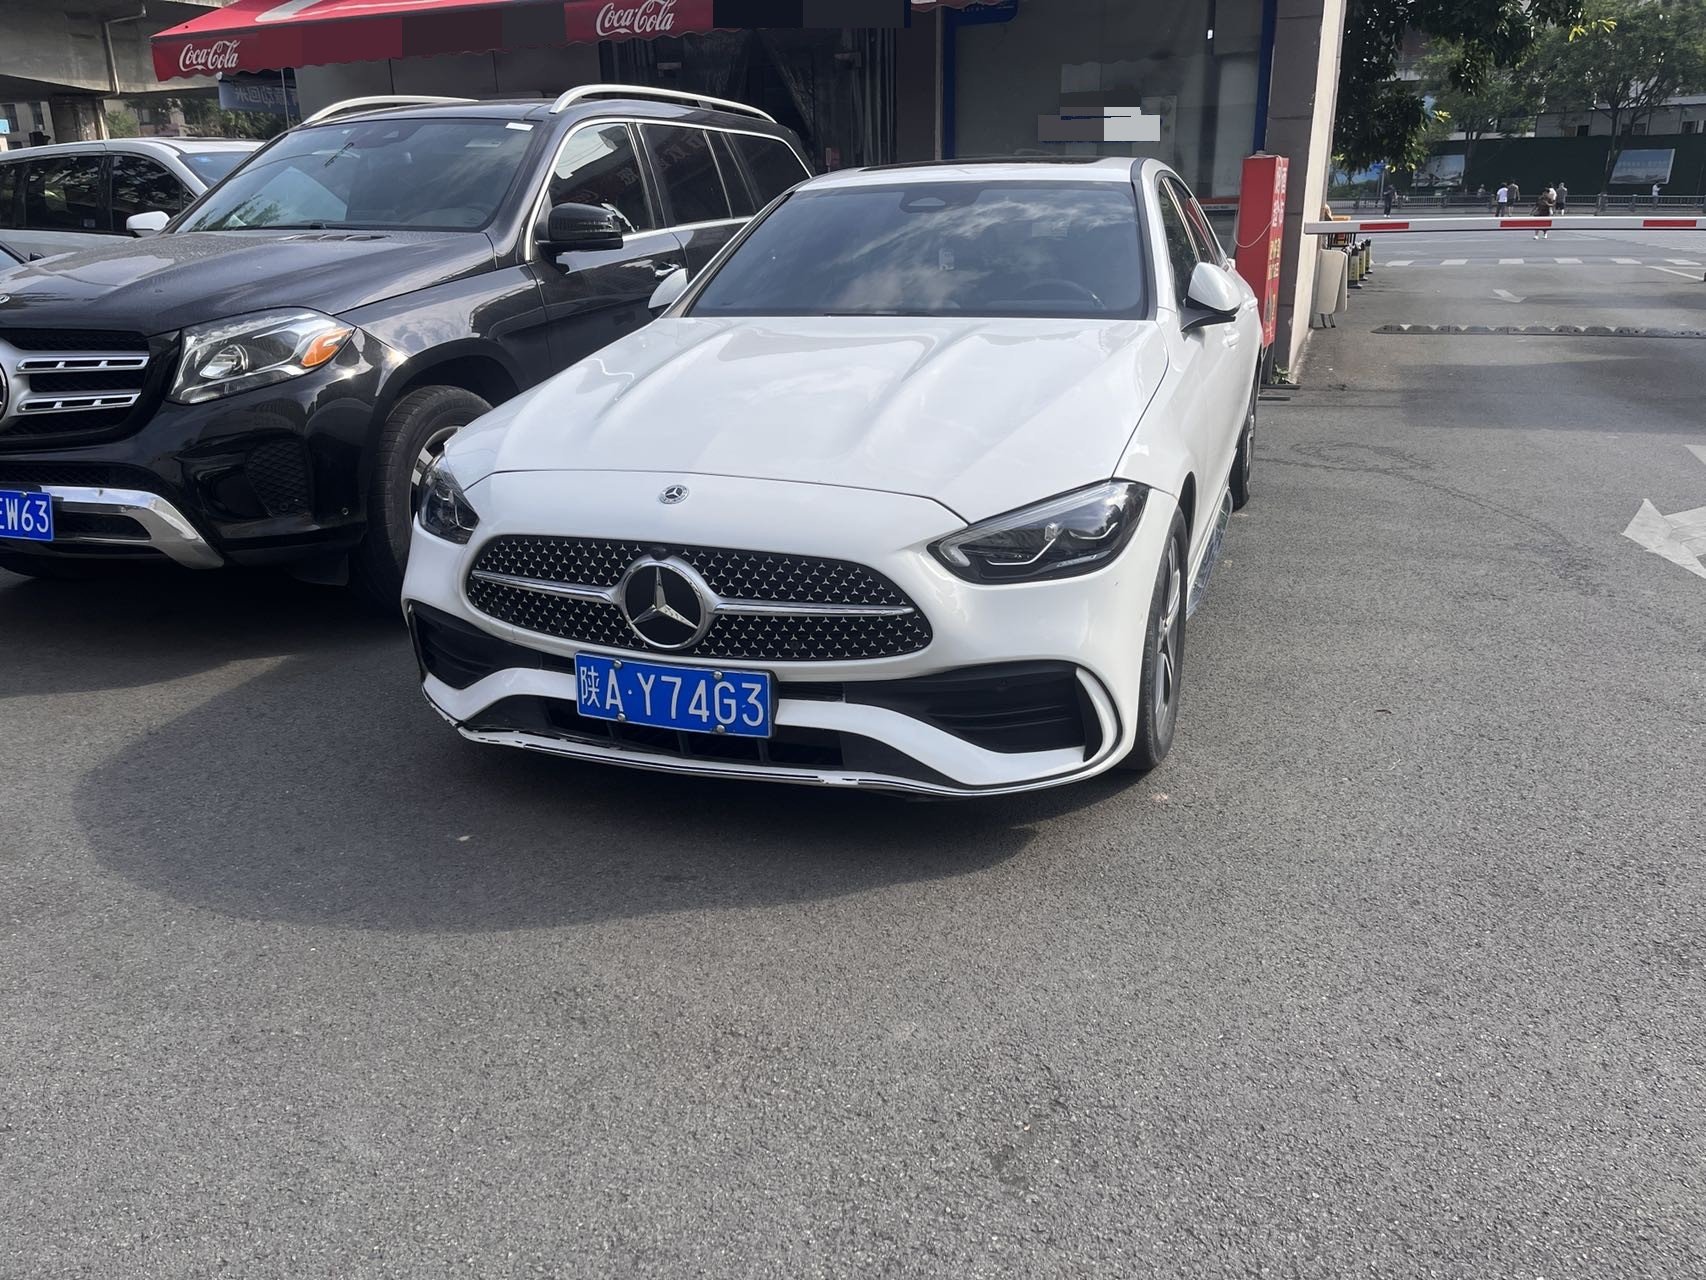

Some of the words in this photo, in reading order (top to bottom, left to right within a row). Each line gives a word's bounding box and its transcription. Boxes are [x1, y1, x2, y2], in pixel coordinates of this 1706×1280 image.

[596, 0, 675, 36] Coca-Cola
[179, 40, 240, 72] Coca-Cola
[579, 665, 765, 727] 陕A·Y74G3
